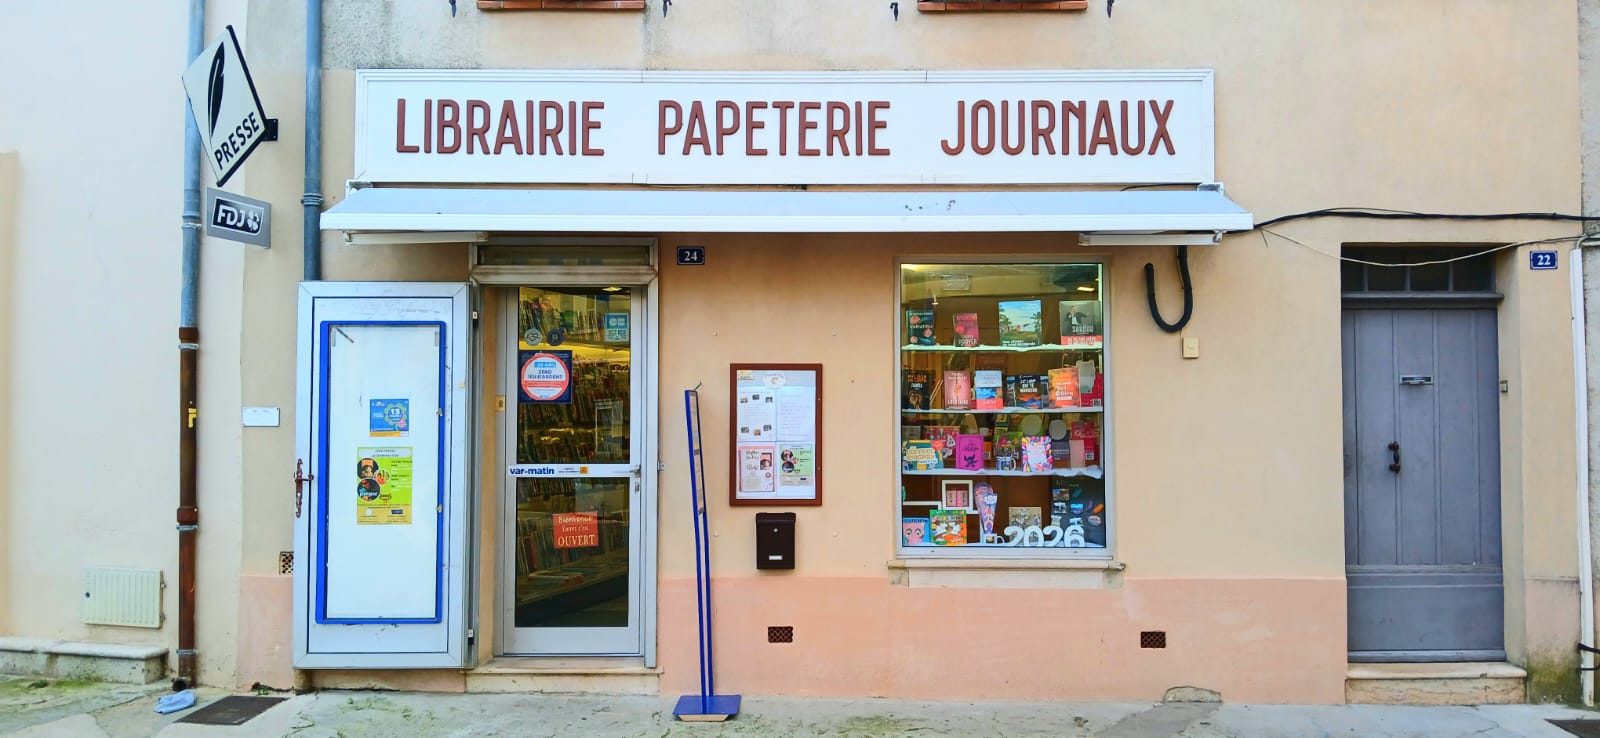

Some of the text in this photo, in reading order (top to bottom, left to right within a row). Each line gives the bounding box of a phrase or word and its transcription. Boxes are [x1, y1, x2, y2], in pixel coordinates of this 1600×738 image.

[396, 98, 1175, 156] LIBRAIRIE PAPETERIE JOURNAUX
[213, 111, 260, 170] PRESSE
[217, 205, 246, 228] FDJ
[684, 251, 698, 261] 24
[1537, 254, 1551, 266] 22
[510, 466, 555, 475] var-matin
[558, 534, 595, 547] OUVERT
[1004, 525, 1086, 547] 2026
